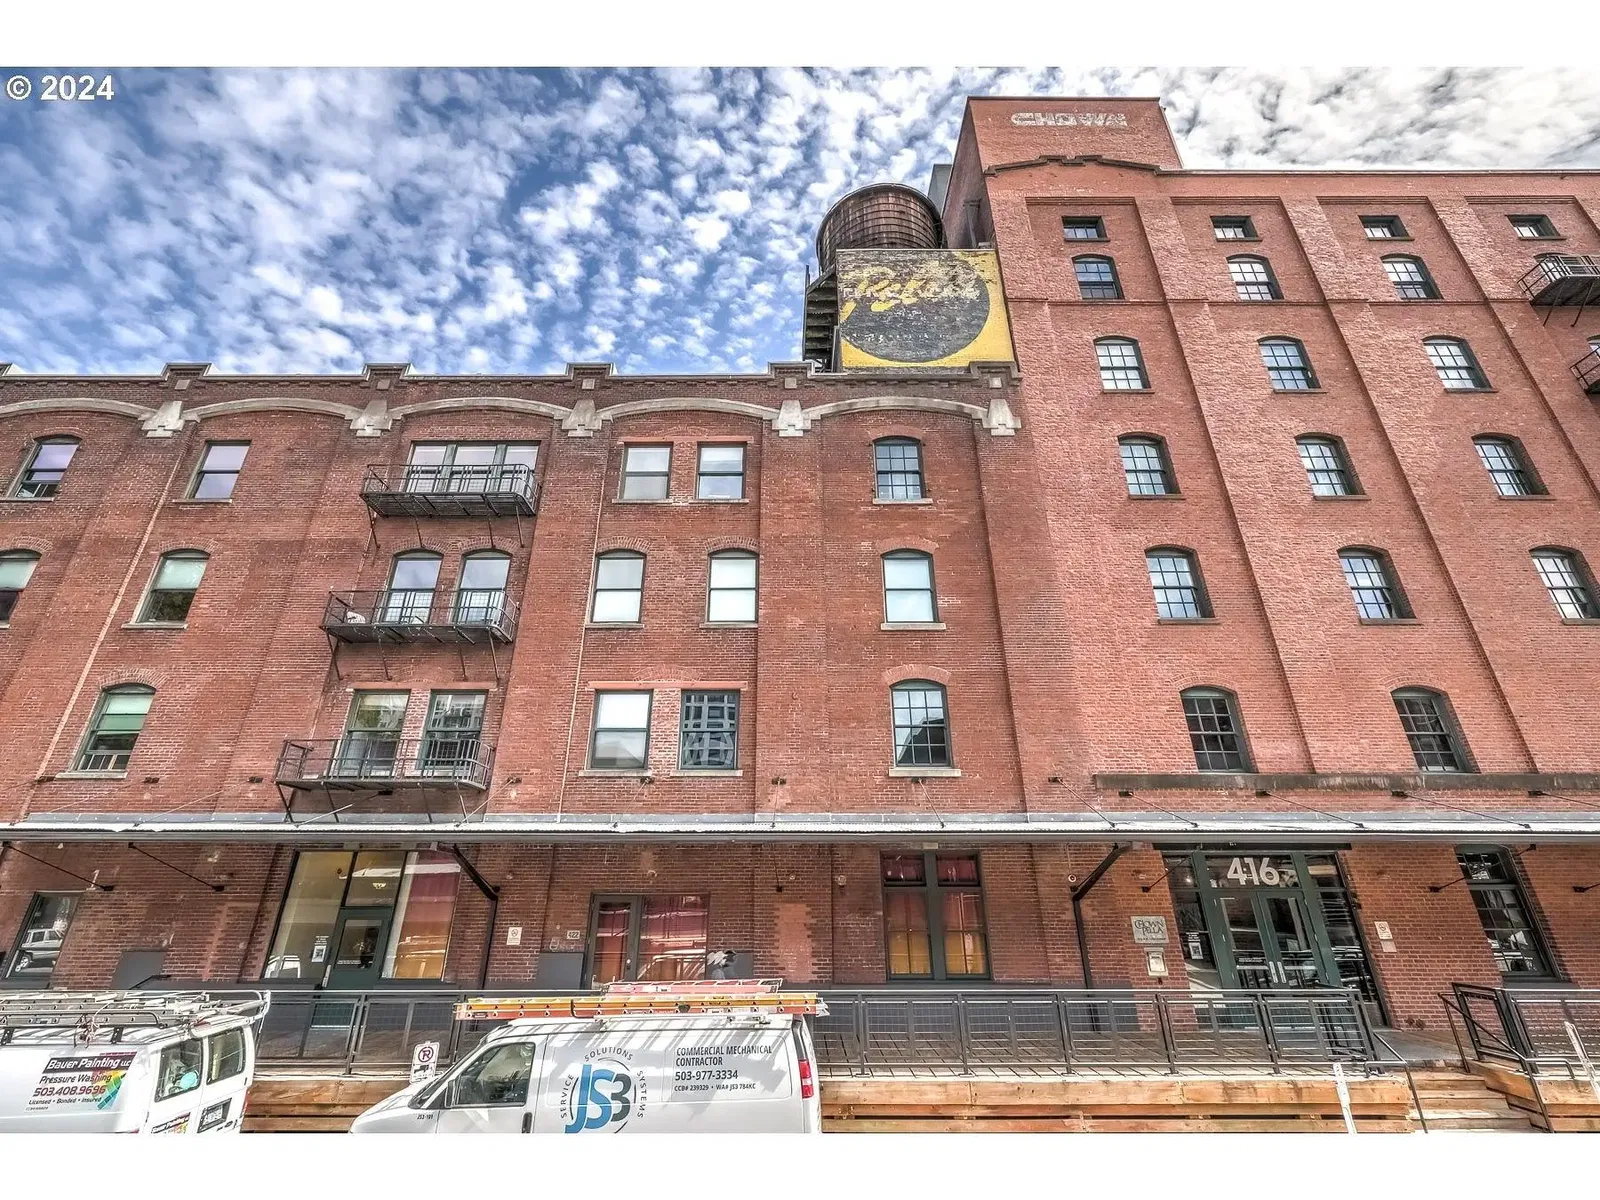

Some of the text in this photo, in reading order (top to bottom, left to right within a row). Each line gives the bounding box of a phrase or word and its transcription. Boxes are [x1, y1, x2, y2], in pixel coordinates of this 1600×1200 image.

[1226, 857, 1280, 886] 416
[568, 931, 579, 939] 422
[584, 1046, 633, 1062] SOLUTIONS
[676, 1045, 773, 1056] COMMERCIAL MECHANICAL
[47, 1060, 78, 1069] Bauer
[78, 1057, 120, 1069] Painting
[675, 1057, 723, 1067] CONTRACTOR
[39, 1073, 112, 1084] Pressure Washing
[674, 1069, 739, 1081] 503-977-3334
[32, 1085, 108, 1097] 503.408.9696
[560, 1074, 574, 1119] SERVICE
[637, 1070, 647, 1118] SYSTEMS
